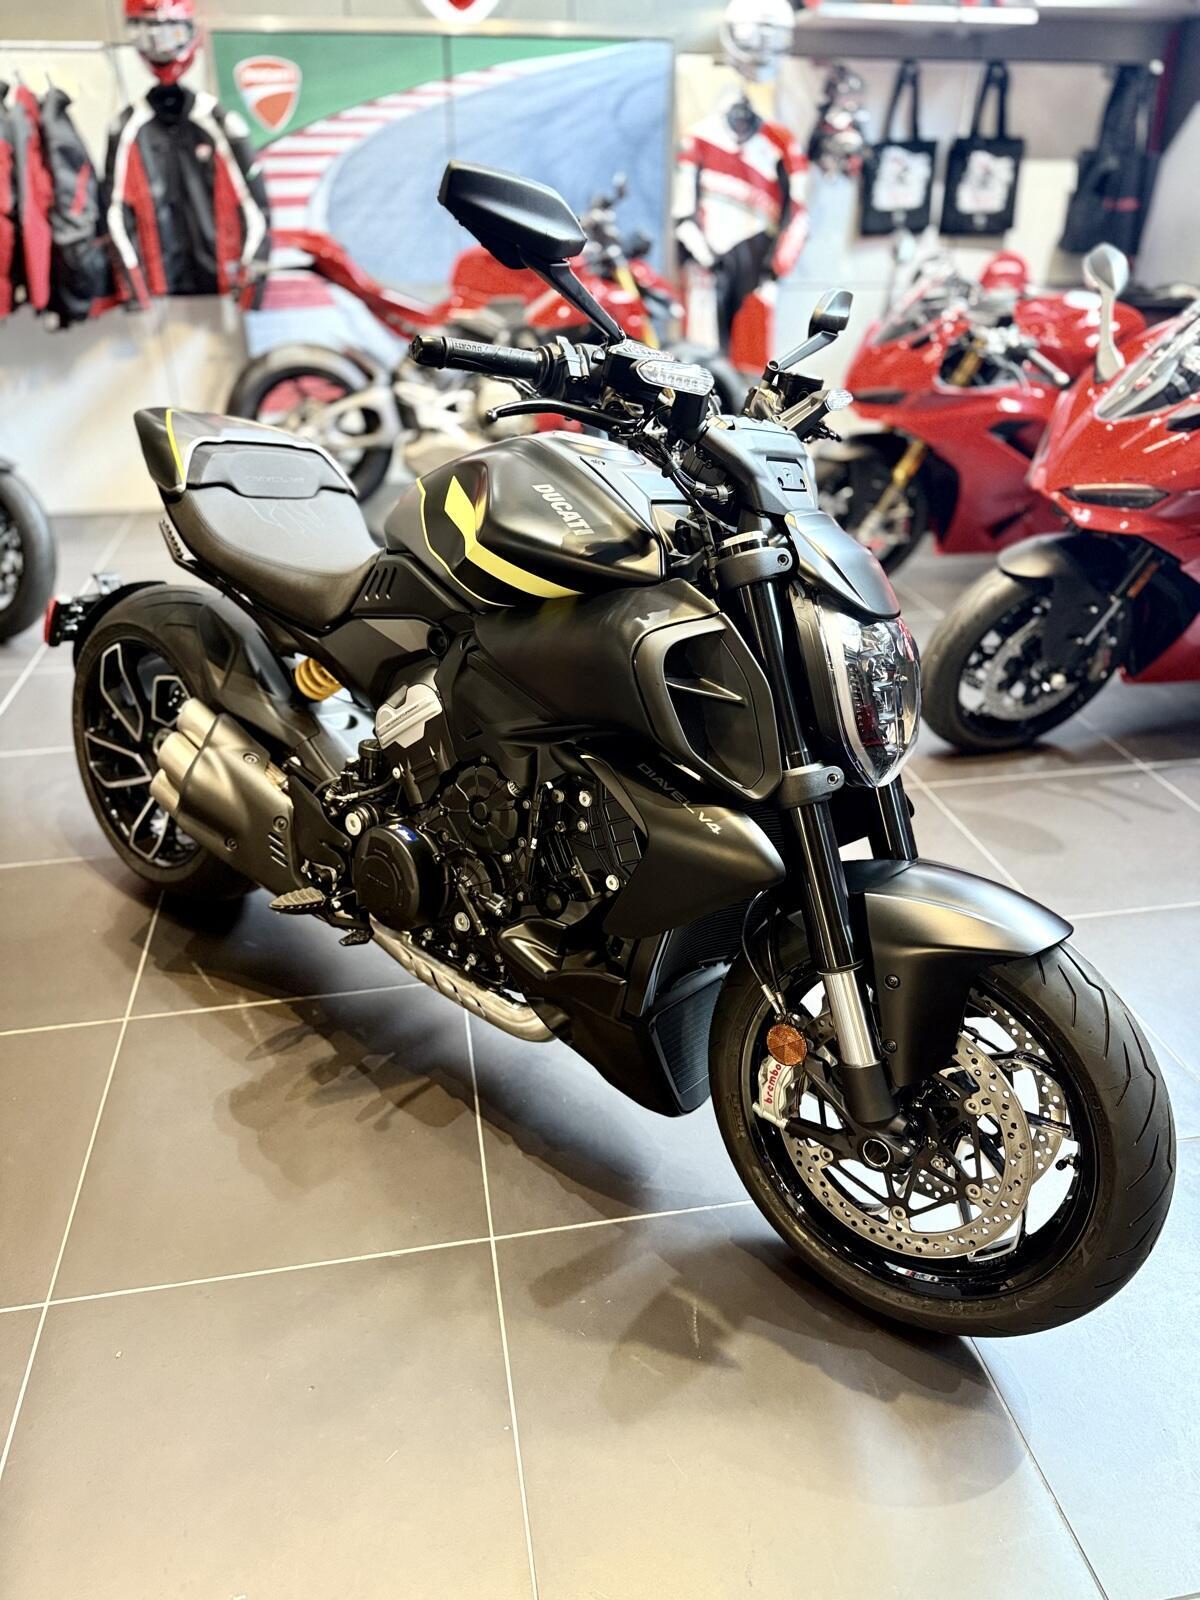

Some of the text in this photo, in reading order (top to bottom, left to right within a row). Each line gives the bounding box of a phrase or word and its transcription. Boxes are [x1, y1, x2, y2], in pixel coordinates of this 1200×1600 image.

[531, 484, 595, 536] DUCATI
[637, 763, 722, 835] DIAVEL V4
[763, 1063, 782, 1105] brembo
